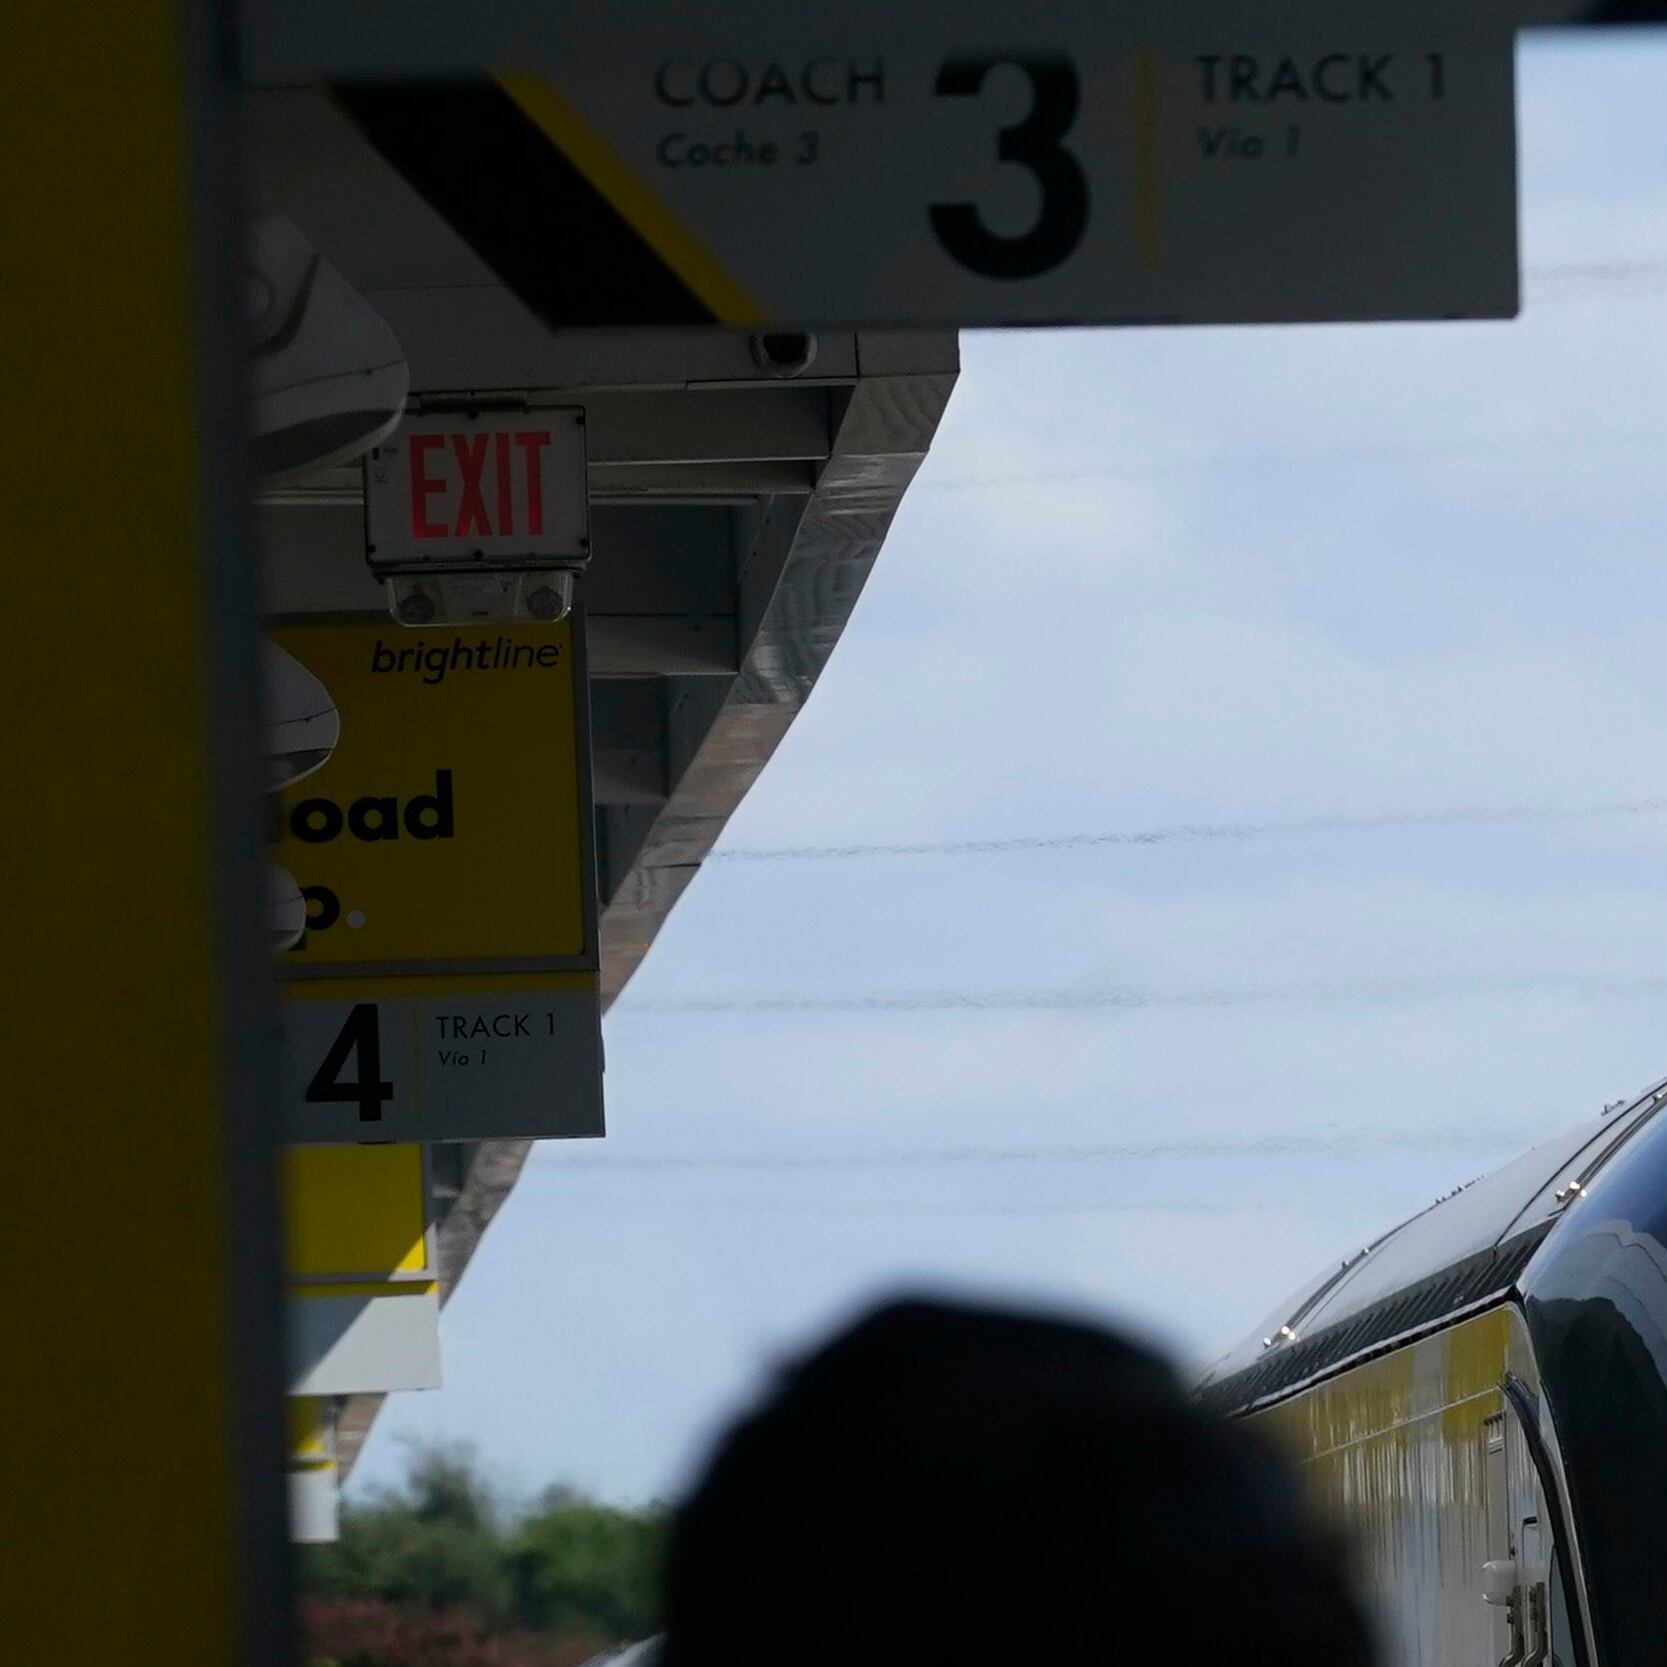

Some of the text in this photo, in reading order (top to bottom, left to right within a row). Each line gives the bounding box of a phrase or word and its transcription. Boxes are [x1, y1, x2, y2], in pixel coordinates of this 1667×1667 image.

[652, 54, 886, 109] COACH
[1193, 51, 1446, 103] TRACK 1
[655, 130, 821, 168] Coche 3
[925, 47, 1092, 282] 3
[1285, 124, 1302, 158] 1
[409, 431, 551, 539] EXIT
[370, 636, 563, 685] brightline
[436, 1012, 556, 1039] TRACK 1
[305, 1003, 394, 1122] 4
[479, 1049, 487, 1065] 1
